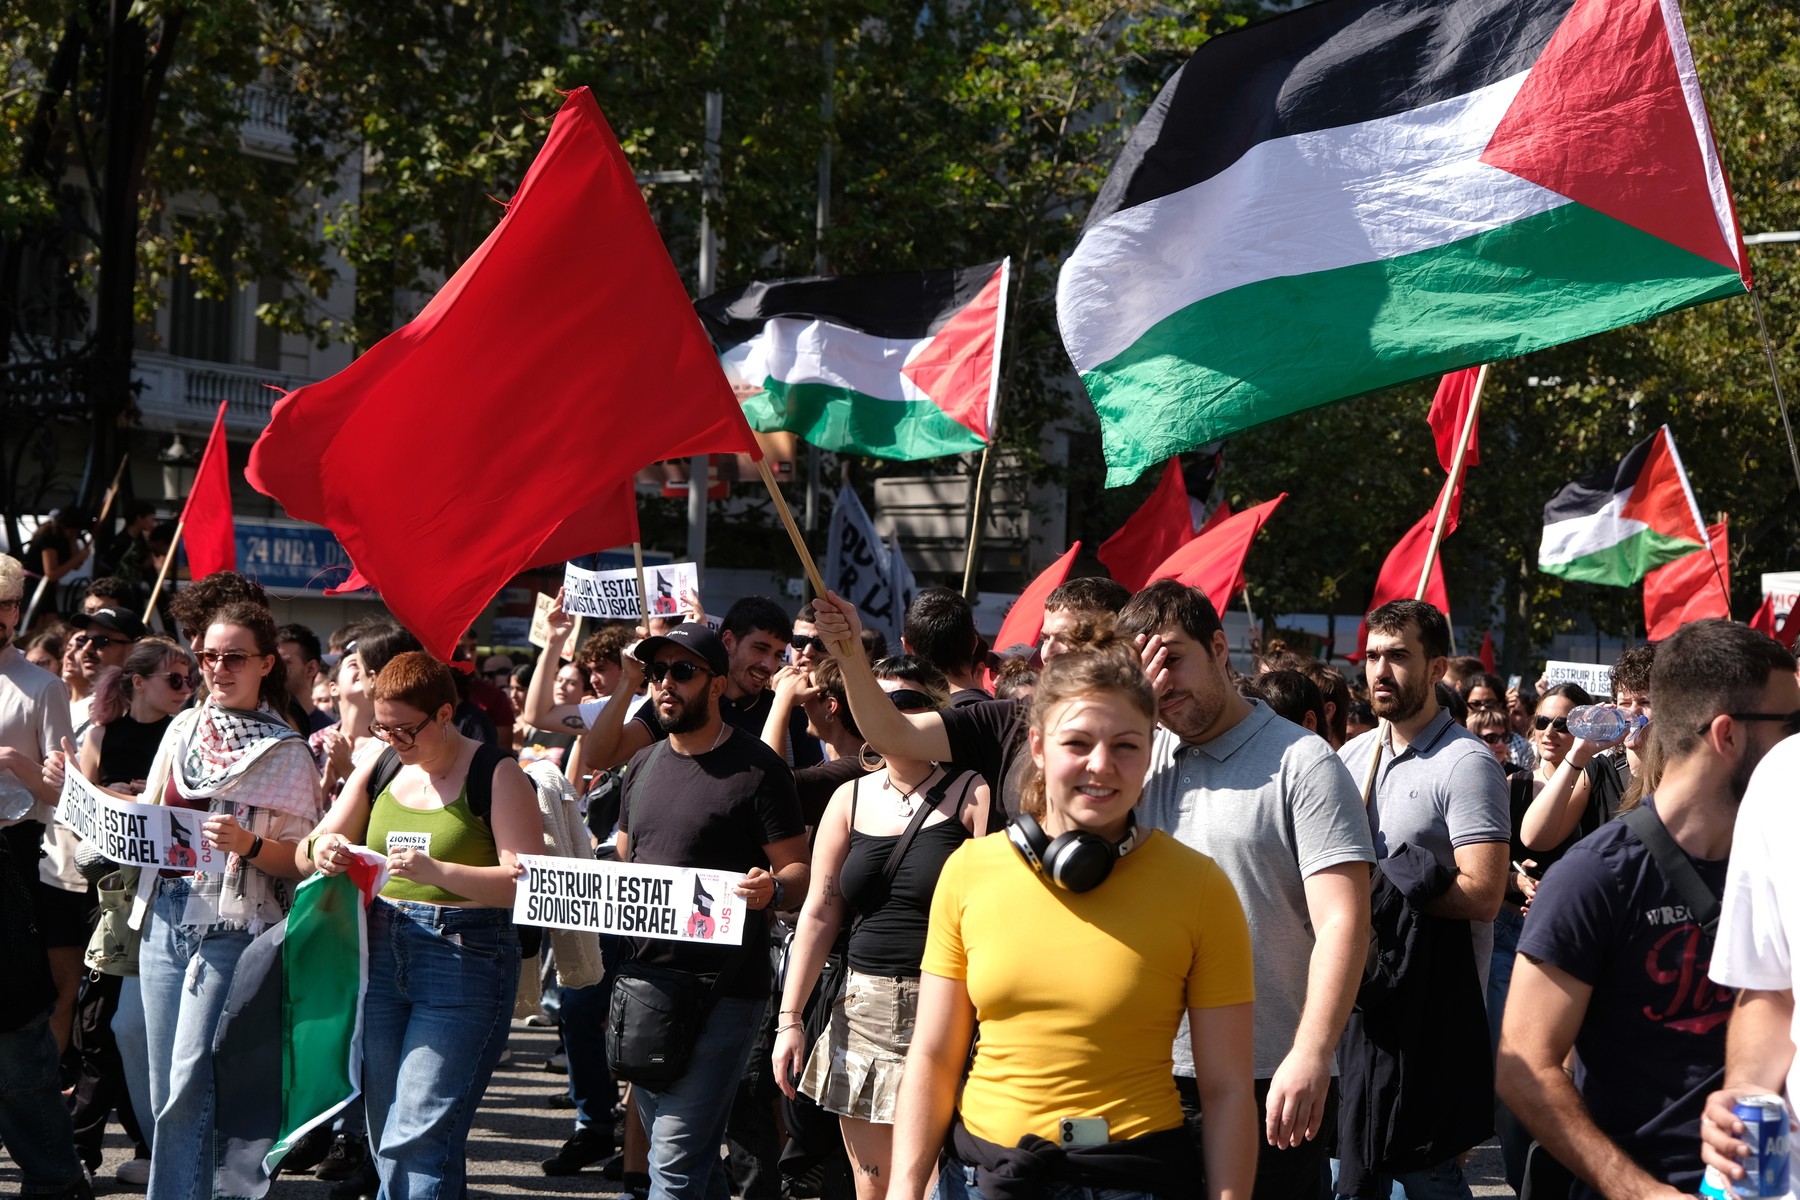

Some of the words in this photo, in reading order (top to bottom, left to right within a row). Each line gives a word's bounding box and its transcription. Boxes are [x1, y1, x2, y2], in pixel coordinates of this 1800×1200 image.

[273, 538, 317, 566] FIRA
[1551, 667, 1590, 681] DESTRUIR
[67, 774, 98, 821] DESTRUIR
[64, 799, 98, 846] SIONISTA
[389, 835, 427, 844] ZIONISTS
[529, 867, 602, 900] DESTRUIR
[606, 874, 673, 906] L'ESTAT
[527, 895, 600, 928] SIONISTA
[604, 902, 678, 935] D'ISRAEL
[1645, 906, 1694, 926] WRE
